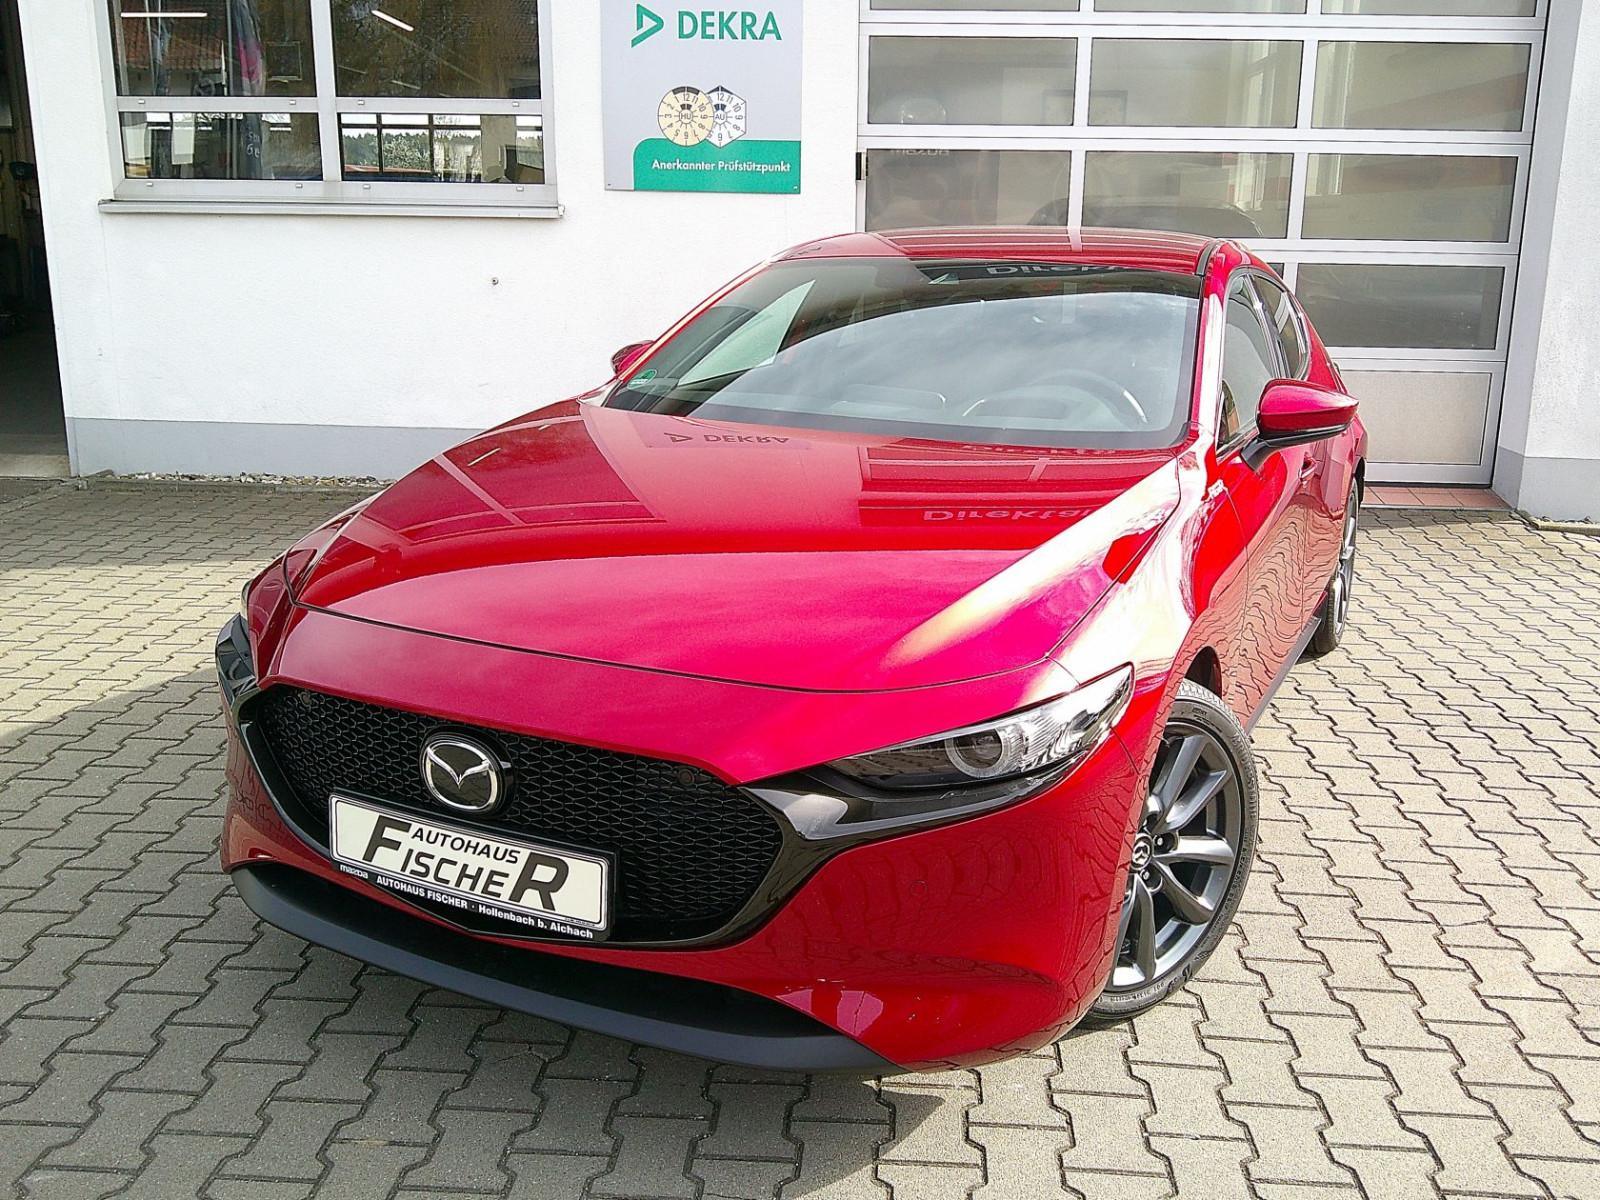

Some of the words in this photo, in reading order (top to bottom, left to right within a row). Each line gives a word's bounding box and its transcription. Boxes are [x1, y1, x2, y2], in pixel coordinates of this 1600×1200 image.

[678, 10, 782, 40] DEKRA
[683, 93, 690, 101] 12
[717, 92, 725, 101] 12
[732, 103, 742, 113] 10
[680, 112, 691, 120] HU
[714, 113, 726, 121] AU
[652, 158, 716, 171] Anerkannter
[718, 160, 791, 175] Prüfstützpunkt
[411, 827, 521, 864] AUTOHAUS
[362, 814, 569, 911] FISCHER
[340, 864, 369, 879] mazda
[376, 875, 425, 897] AUTOHAUS
[427, 890, 468, 909] FISCHER
[478, 904, 535, 926] Hollenbach
[537, 918, 548, 930] b.
[550, 922, 593, 939] Aichach
